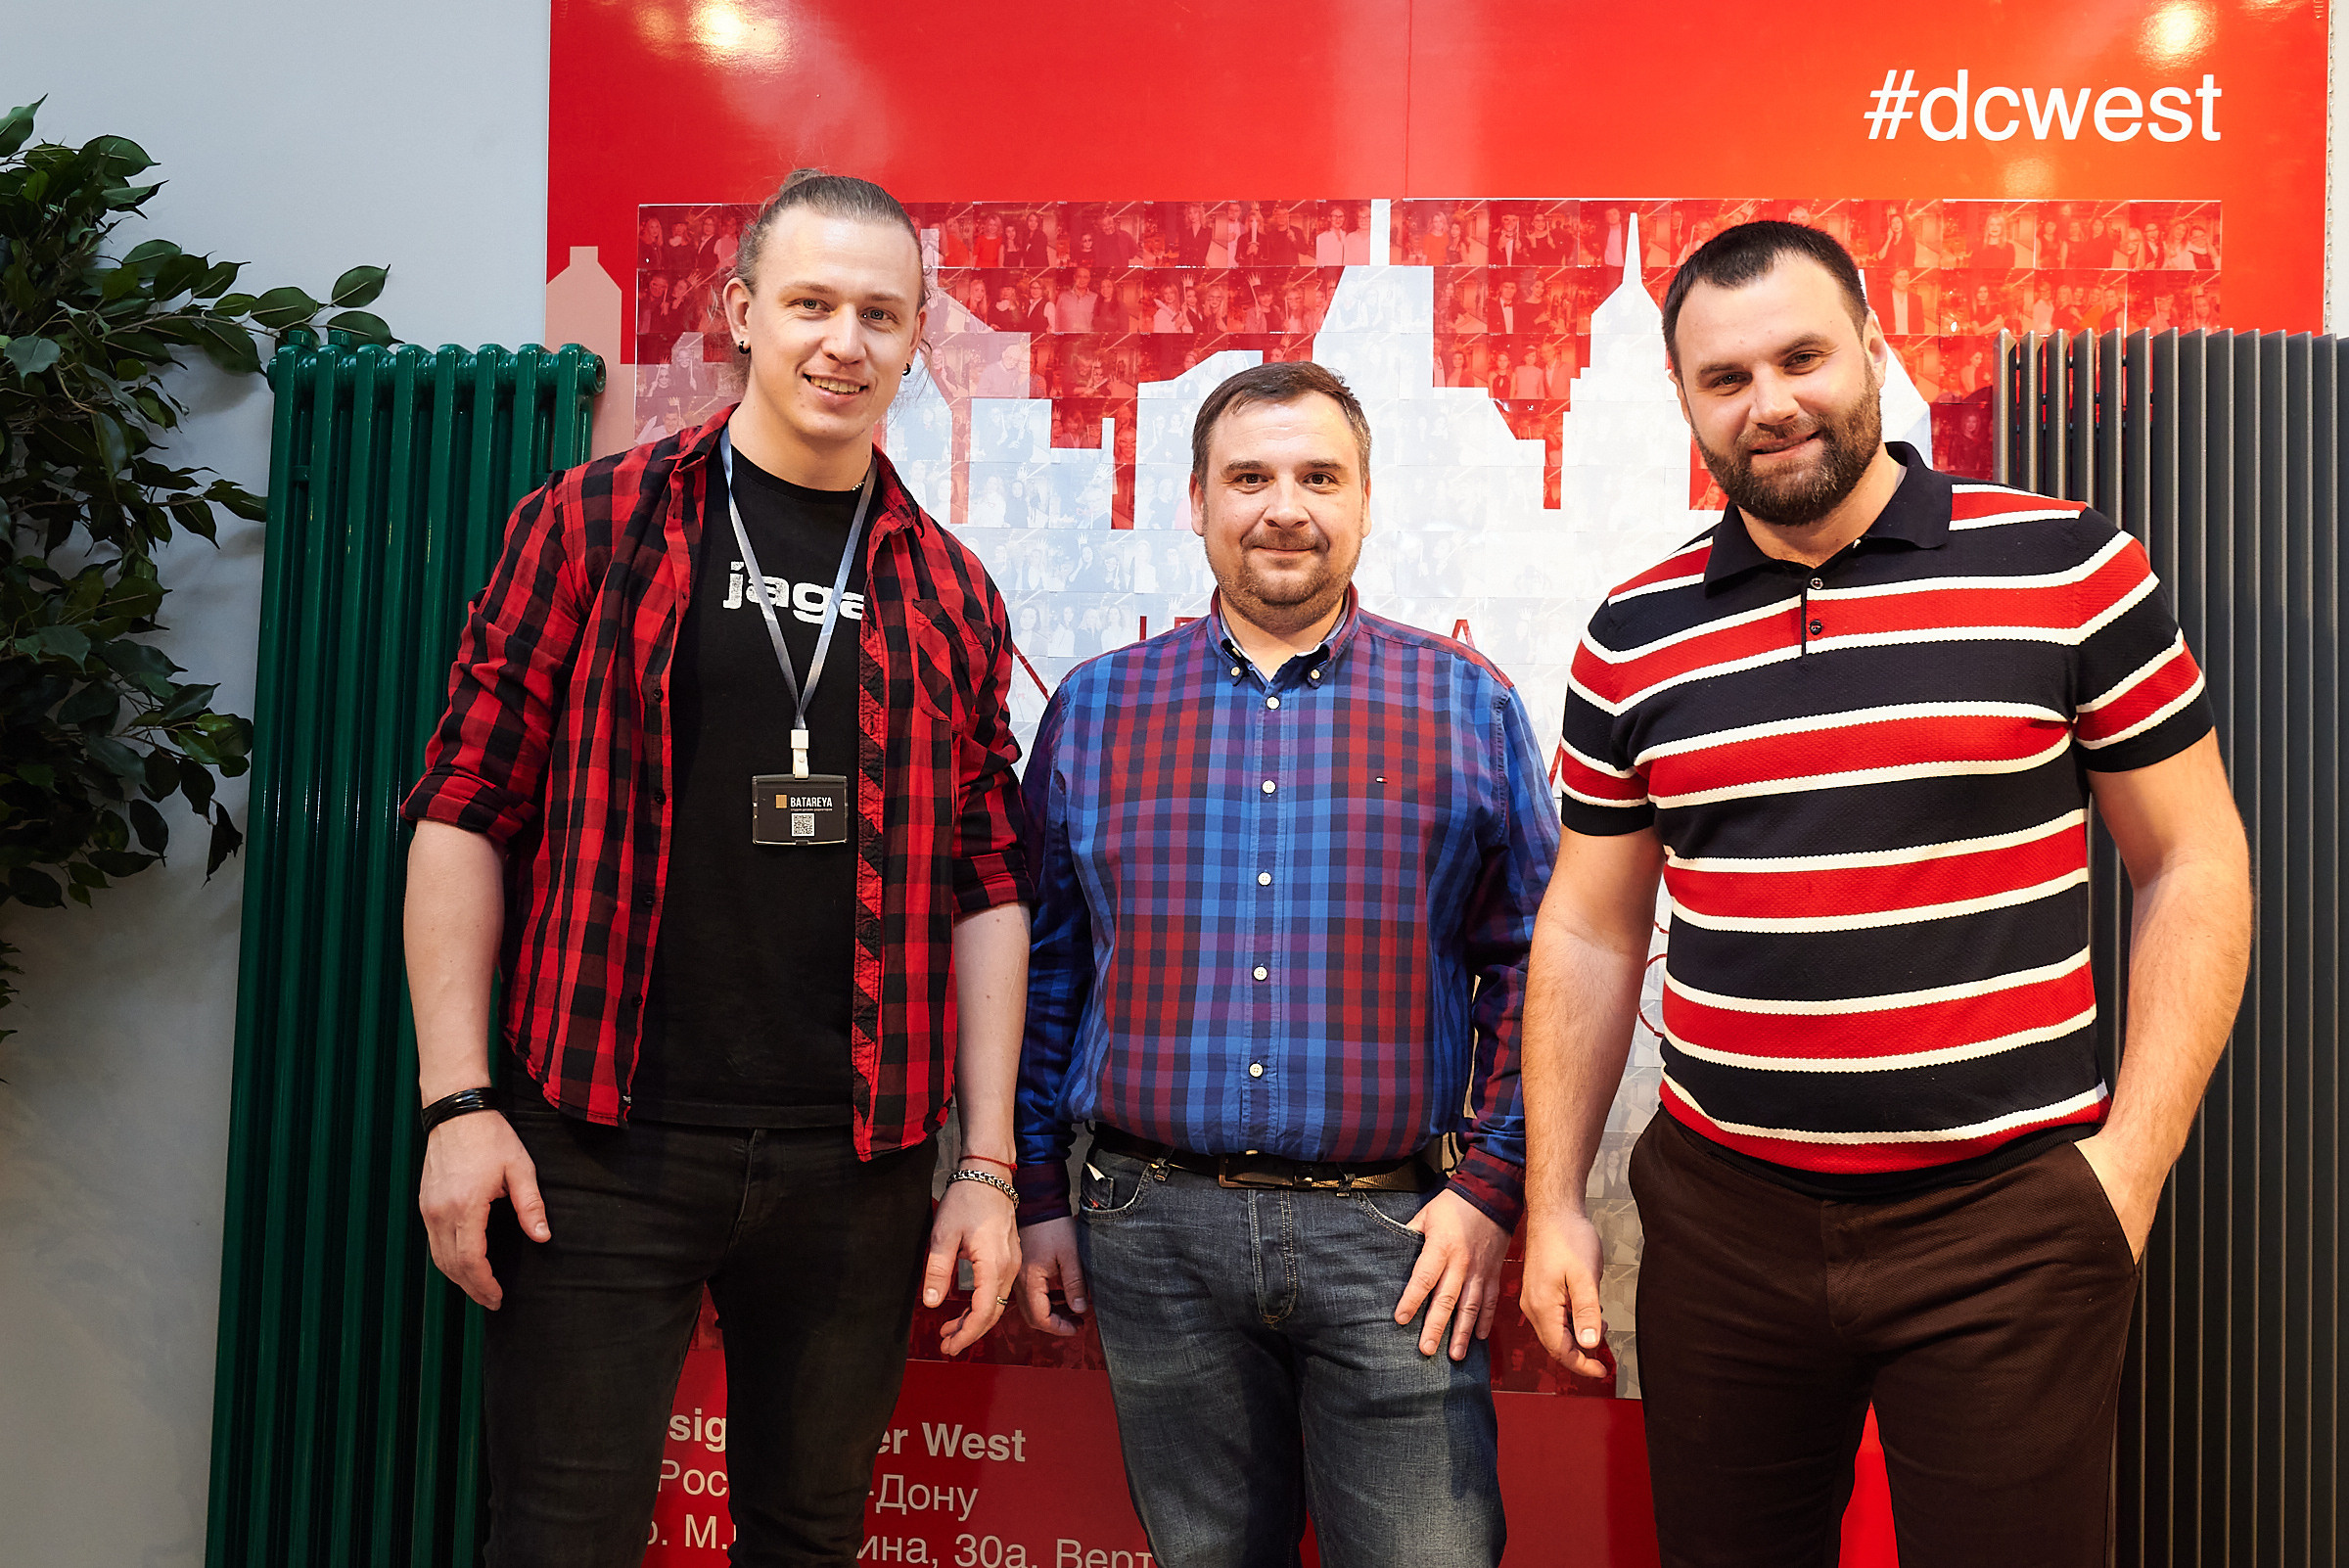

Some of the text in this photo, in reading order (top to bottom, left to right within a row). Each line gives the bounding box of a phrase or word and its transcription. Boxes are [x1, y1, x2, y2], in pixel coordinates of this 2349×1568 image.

[1863, 69, 2223, 143] #dcwest
[790, 796, 833, 807] BATAREYA
[921, 1422, 1027, 1462] West
